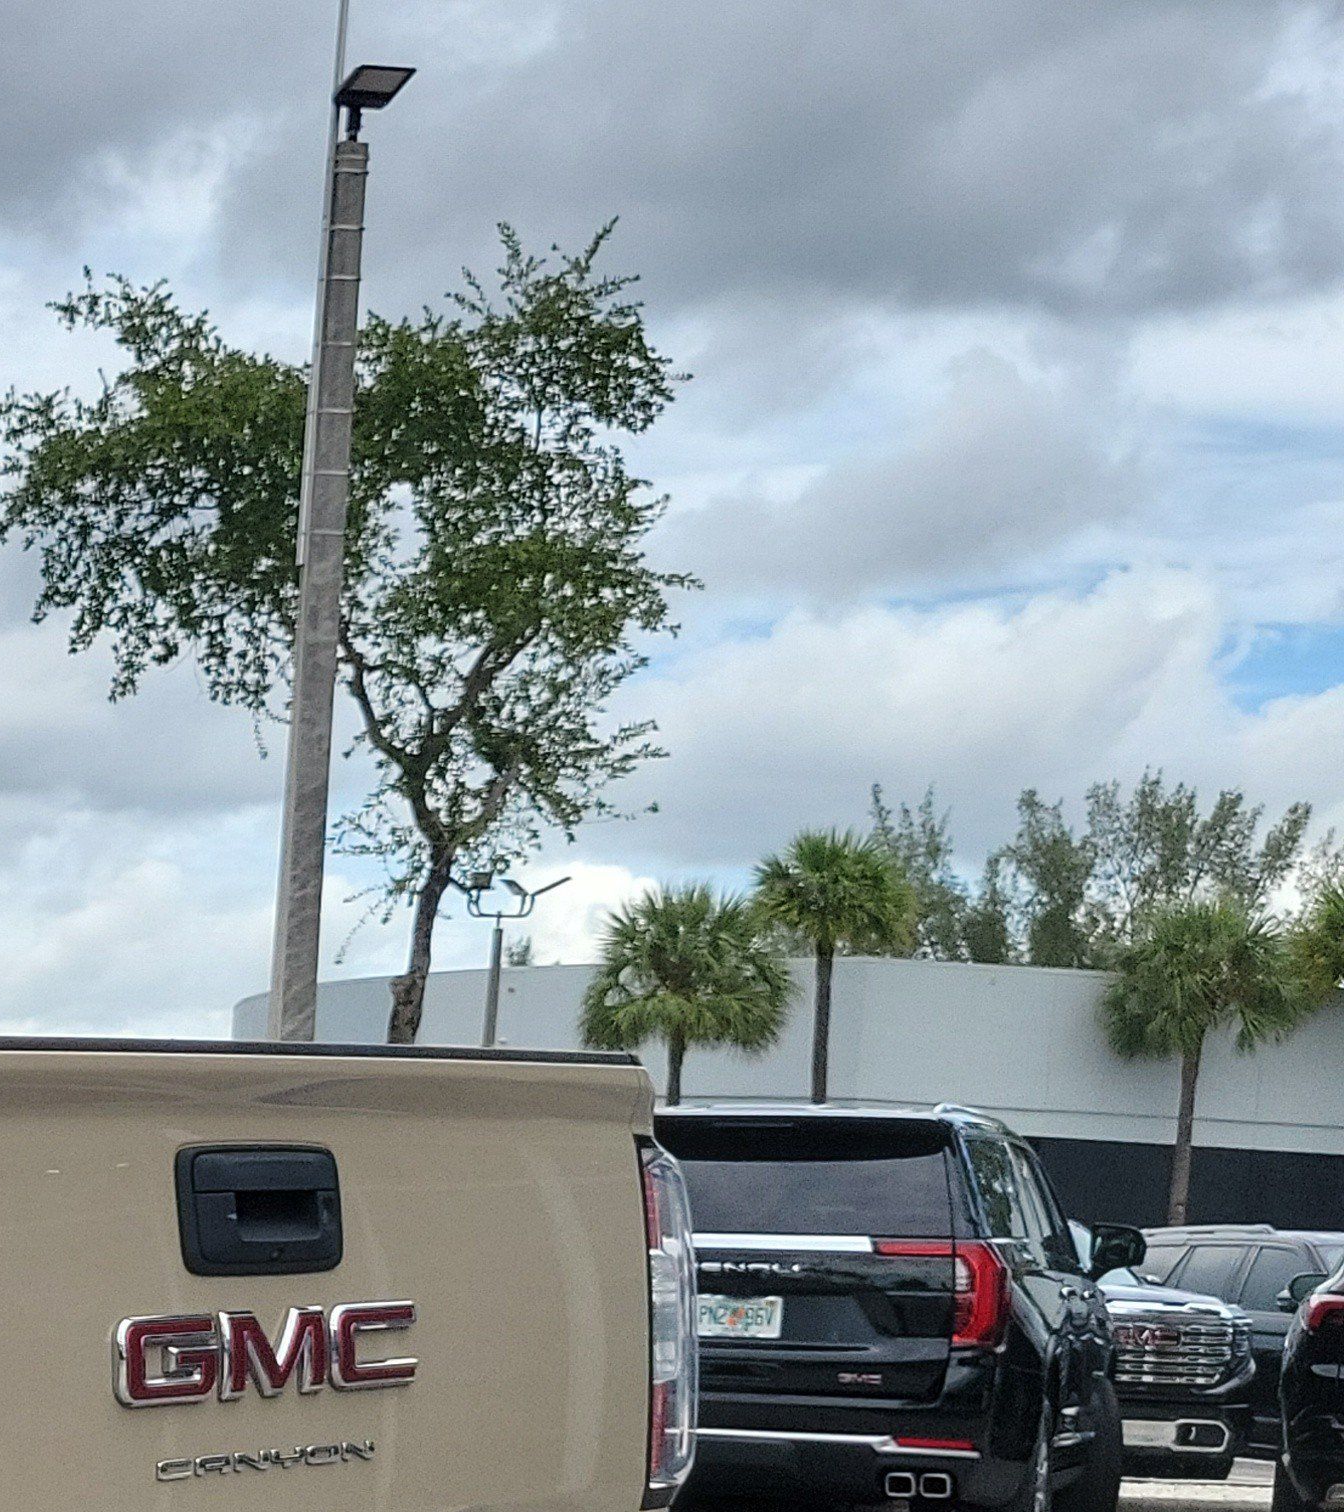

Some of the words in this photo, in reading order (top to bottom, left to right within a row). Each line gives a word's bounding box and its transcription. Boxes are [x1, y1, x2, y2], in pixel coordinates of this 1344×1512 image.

[695, 1262, 802, 1277] ENALI
[113, 1299, 419, 1409] GMC
[155, 1439, 376, 1482] CANYON
